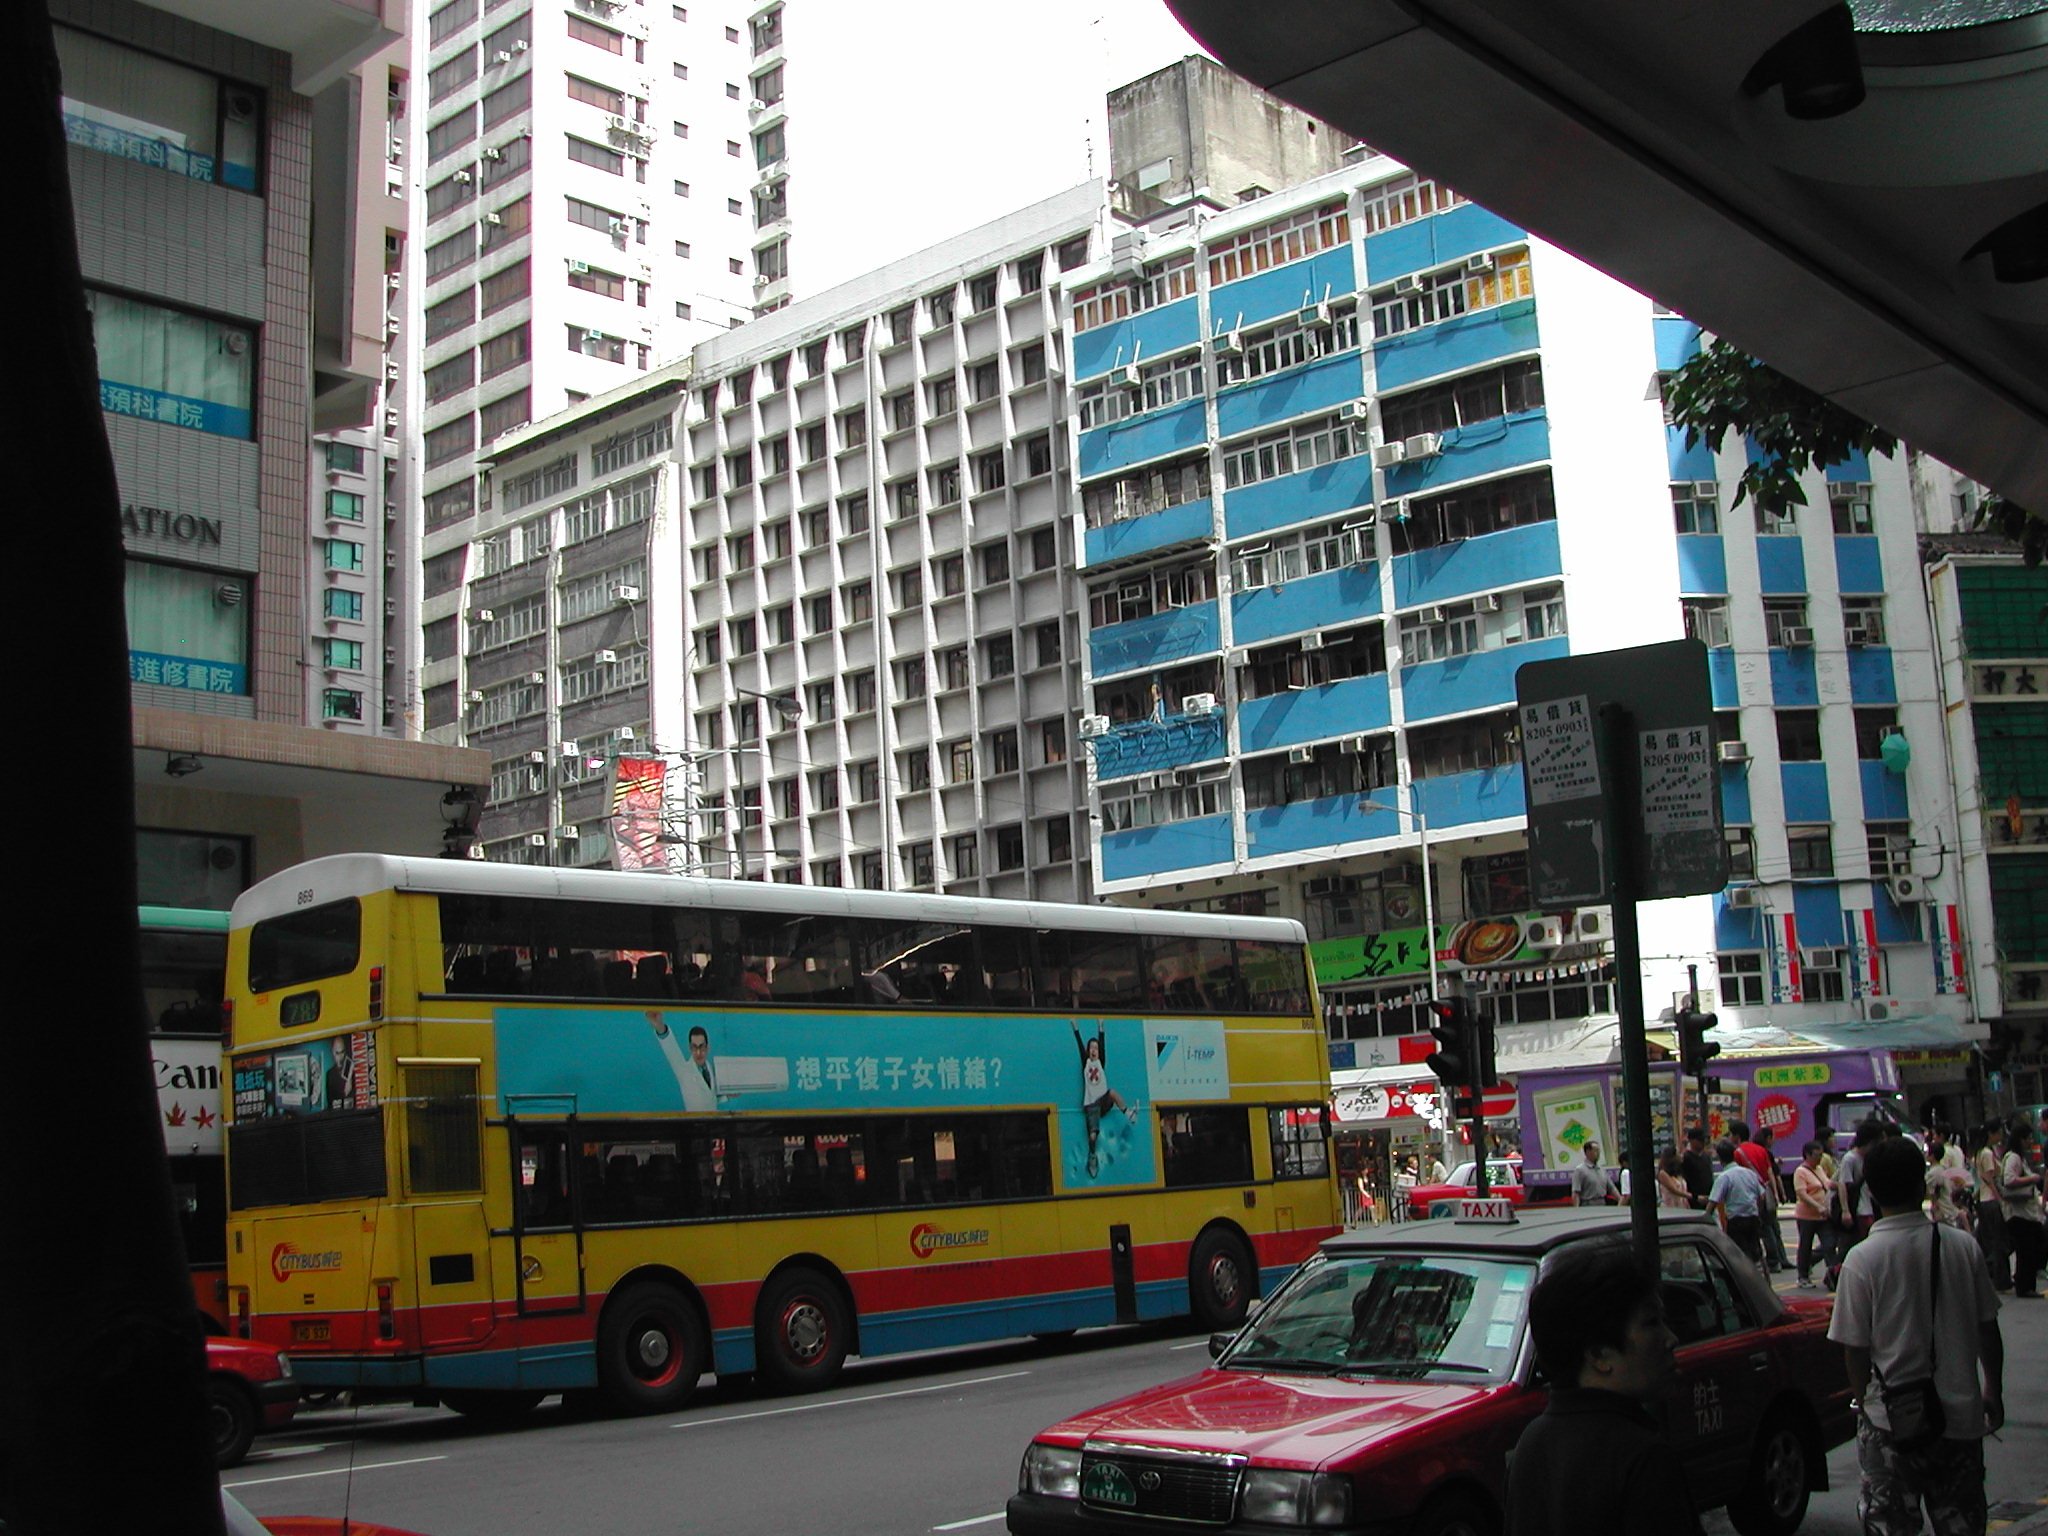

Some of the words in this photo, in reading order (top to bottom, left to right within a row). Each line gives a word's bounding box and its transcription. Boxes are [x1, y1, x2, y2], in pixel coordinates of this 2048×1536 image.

[101, 384, 204, 429] 預科書院
[1526, 725, 1553, 741] 8205
[1555, 720, 1583, 735] 0903
[1643, 753, 1670, 767] 8205
[1673, 750, 1700, 765] 0903
[297, 889, 314, 905] 869
[153, 1060, 222, 1089] Can
[796, 1056, 1002, 1091] 想平復子女情緒?
[1462, 1202, 1502, 1218] TAXI
[1695, 1405, 1722, 1436] TAXI
[1096, 1465, 1120, 1478] TAXI
[1091, 1489, 1127, 1504] SEATS
